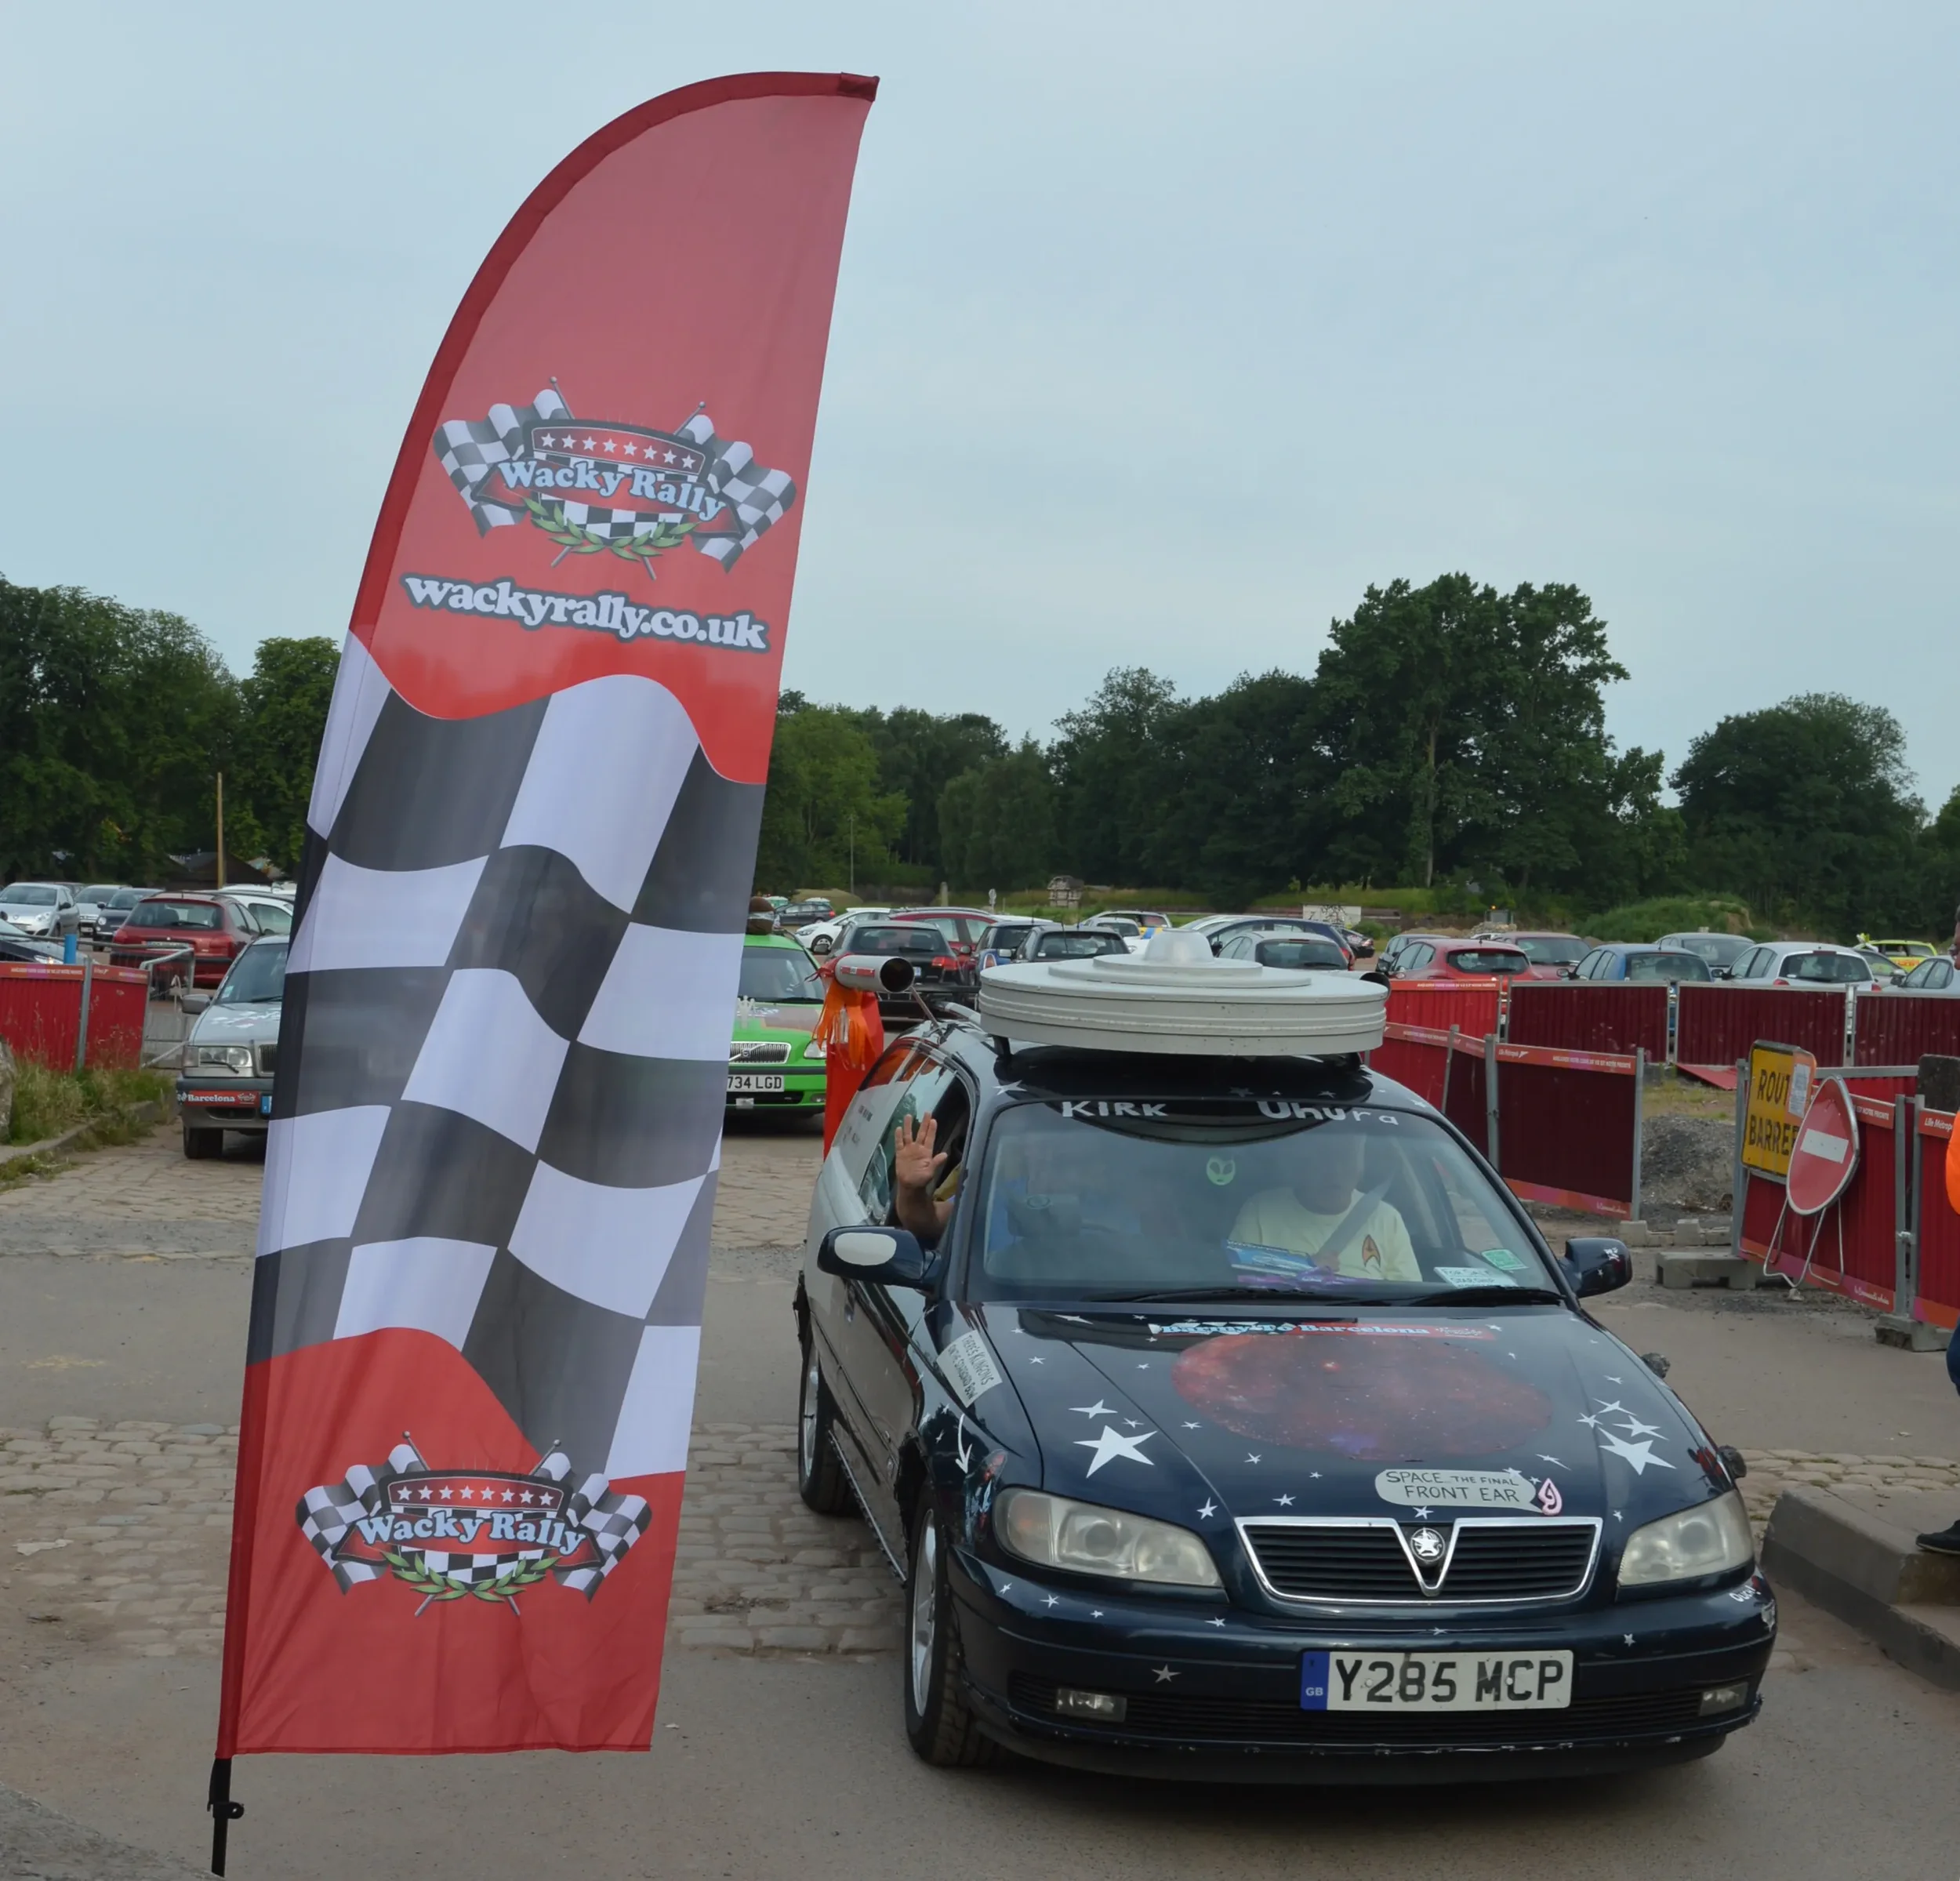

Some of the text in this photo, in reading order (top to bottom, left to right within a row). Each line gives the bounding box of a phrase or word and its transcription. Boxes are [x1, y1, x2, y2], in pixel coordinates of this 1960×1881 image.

[497, 457, 728, 522] Wacky Rally
[403, 576, 768, 650] wackyrally.co.uk
[727, 1076, 782, 1089] 734 LGD
[1756, 1068, 1791, 1106] ROUT
[187, 1094, 236, 1102] Barcelona
[1061, 1099, 1399, 1126] KIRK Uhura
[1298, 1324, 1430, 1334] Barcelona
[969, 1350, 995, 1385] KLINGONS
[1404, 1485, 1520, 1502] FRONT EAR
[1450, 1475, 1476, 1483] THE
[1479, 1476, 1519, 1487] FINAL
[355, 1509, 586, 1556] Wacky Rally
[1305, 1687, 1324, 1697] GB
[1335, 1659, 1564, 1703] Y285 MCP
